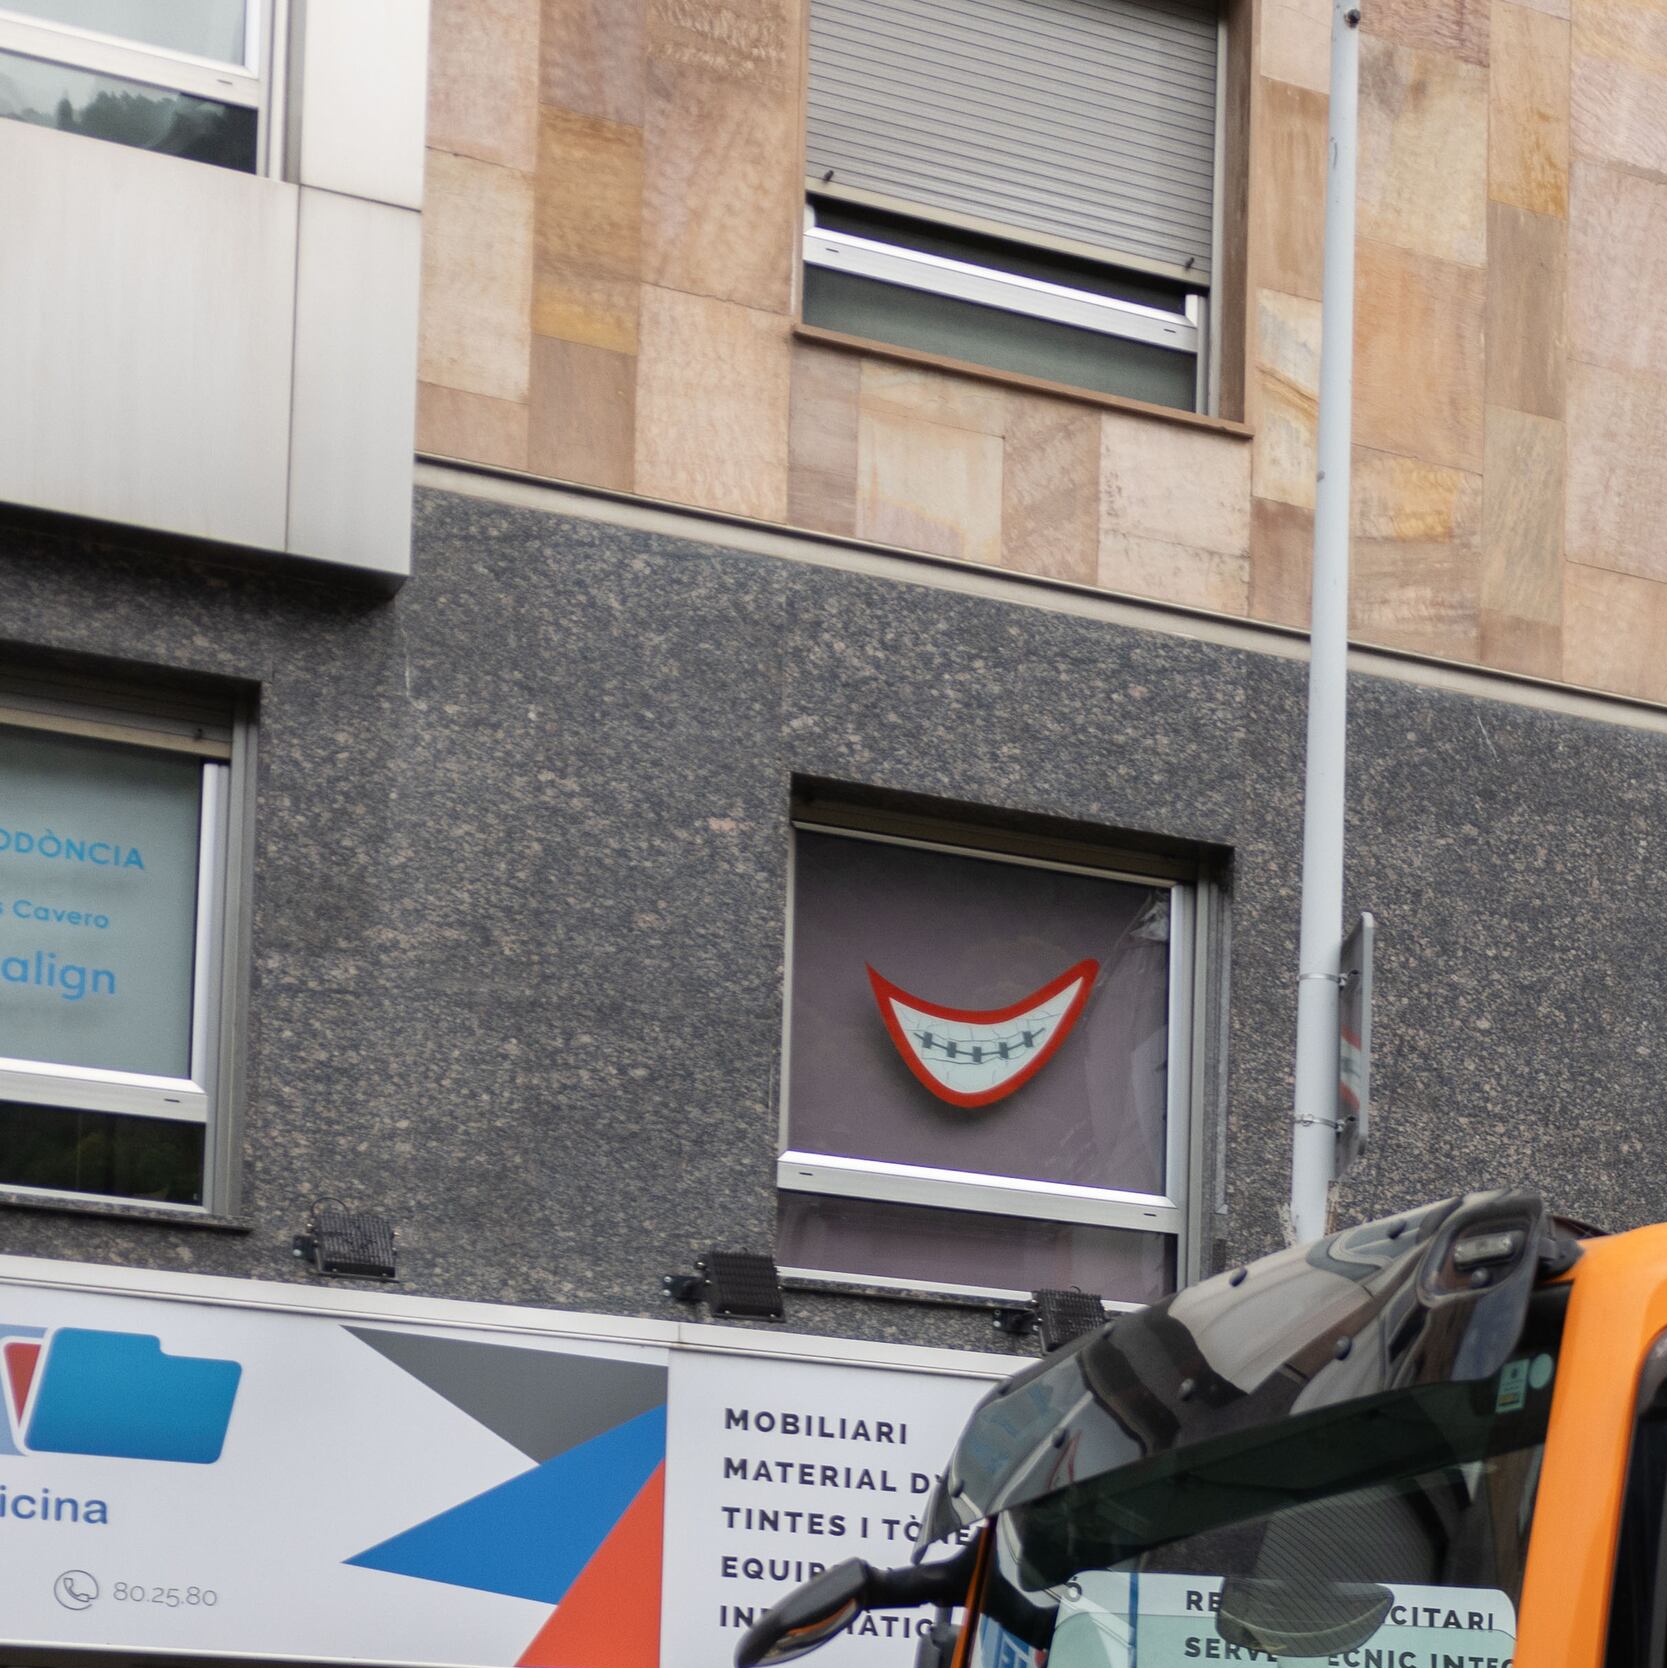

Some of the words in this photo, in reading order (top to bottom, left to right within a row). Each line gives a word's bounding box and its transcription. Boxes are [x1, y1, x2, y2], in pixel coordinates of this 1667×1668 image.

[13, 899, 110, 929] Cavero
[1, 950, 116, 1000] align
[724, 1407, 908, 1445] MOBILIARI
[723, 1457, 897, 1493] MATERIAL
[721, 1506, 847, 1537] TINTES
[861, 1516, 869, 1539] I
[112, 1581, 218, 1608] 80.25.80
